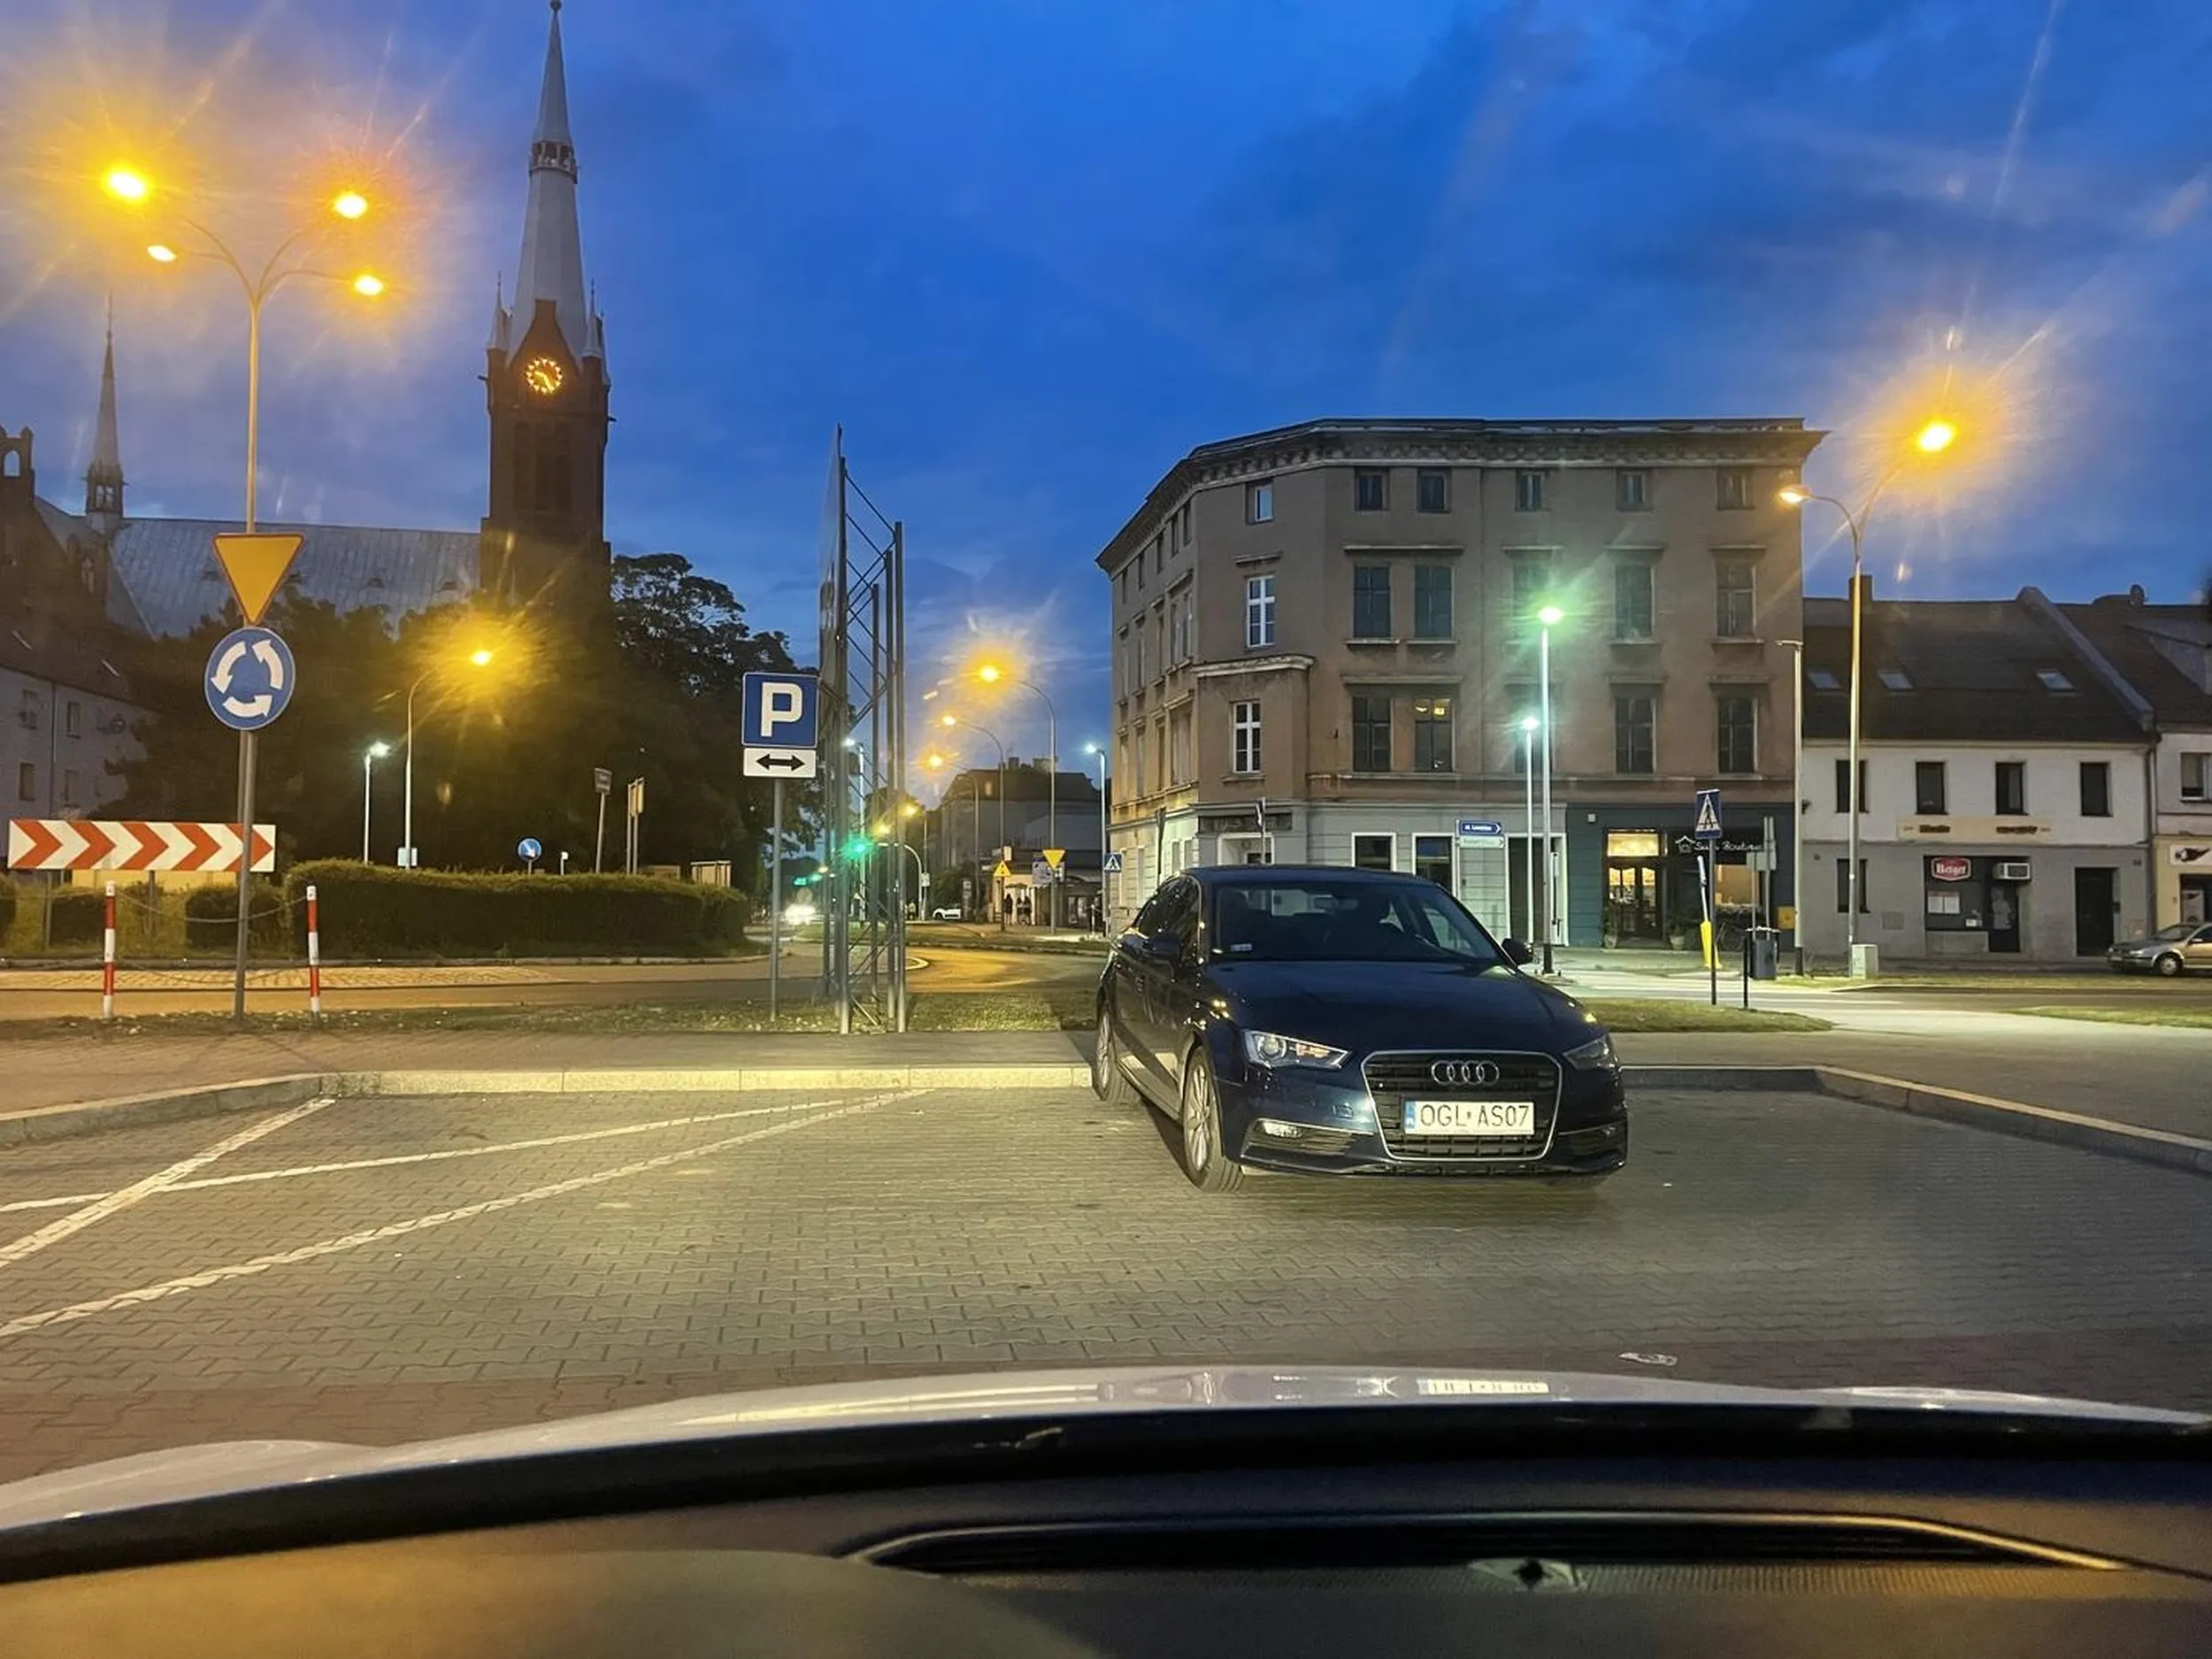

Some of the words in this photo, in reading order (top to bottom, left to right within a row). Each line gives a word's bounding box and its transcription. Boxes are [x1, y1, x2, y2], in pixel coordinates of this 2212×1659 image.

[762, 682, 803, 737] P
[1420, 1104, 1467, 1126] OGL
[1477, 1104, 1529, 1126] AS07
